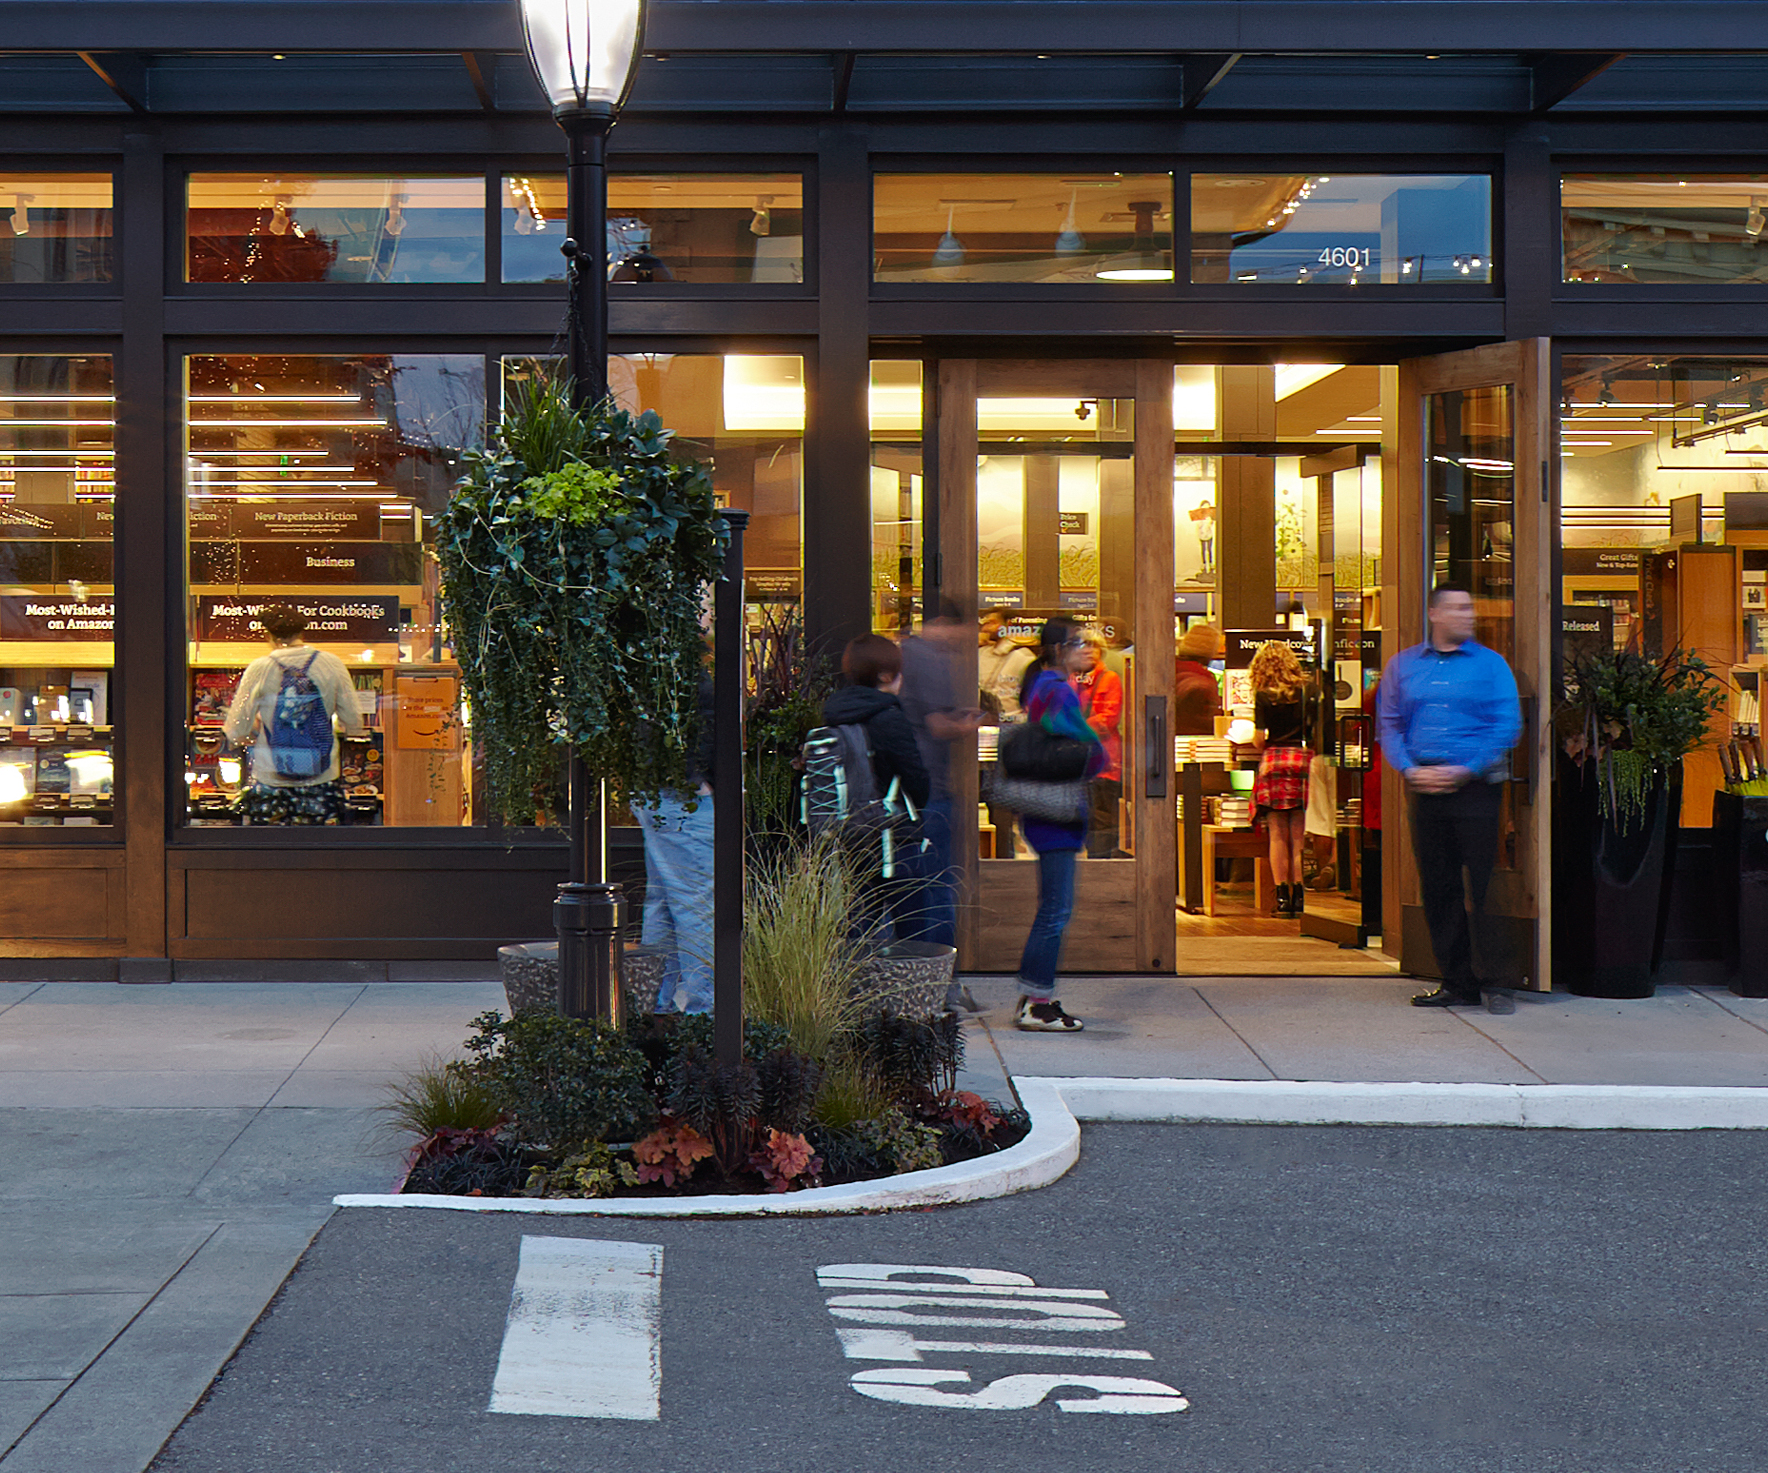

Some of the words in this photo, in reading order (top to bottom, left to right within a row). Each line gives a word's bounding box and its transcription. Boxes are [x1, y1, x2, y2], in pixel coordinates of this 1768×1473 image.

[1318, 247, 1370, 267] 4601
[255, 512, 276, 521] New
[277, 511, 324, 523] Paperback
[325, 512, 358, 521] Fiction
[306, 556, 355, 567] Business
[319, 604, 385, 617] Cookbooks
[47, 620, 65, 630] on
[1562, 620, 1600, 632] Released
[814, 1263, 1189, 1415] STOP
